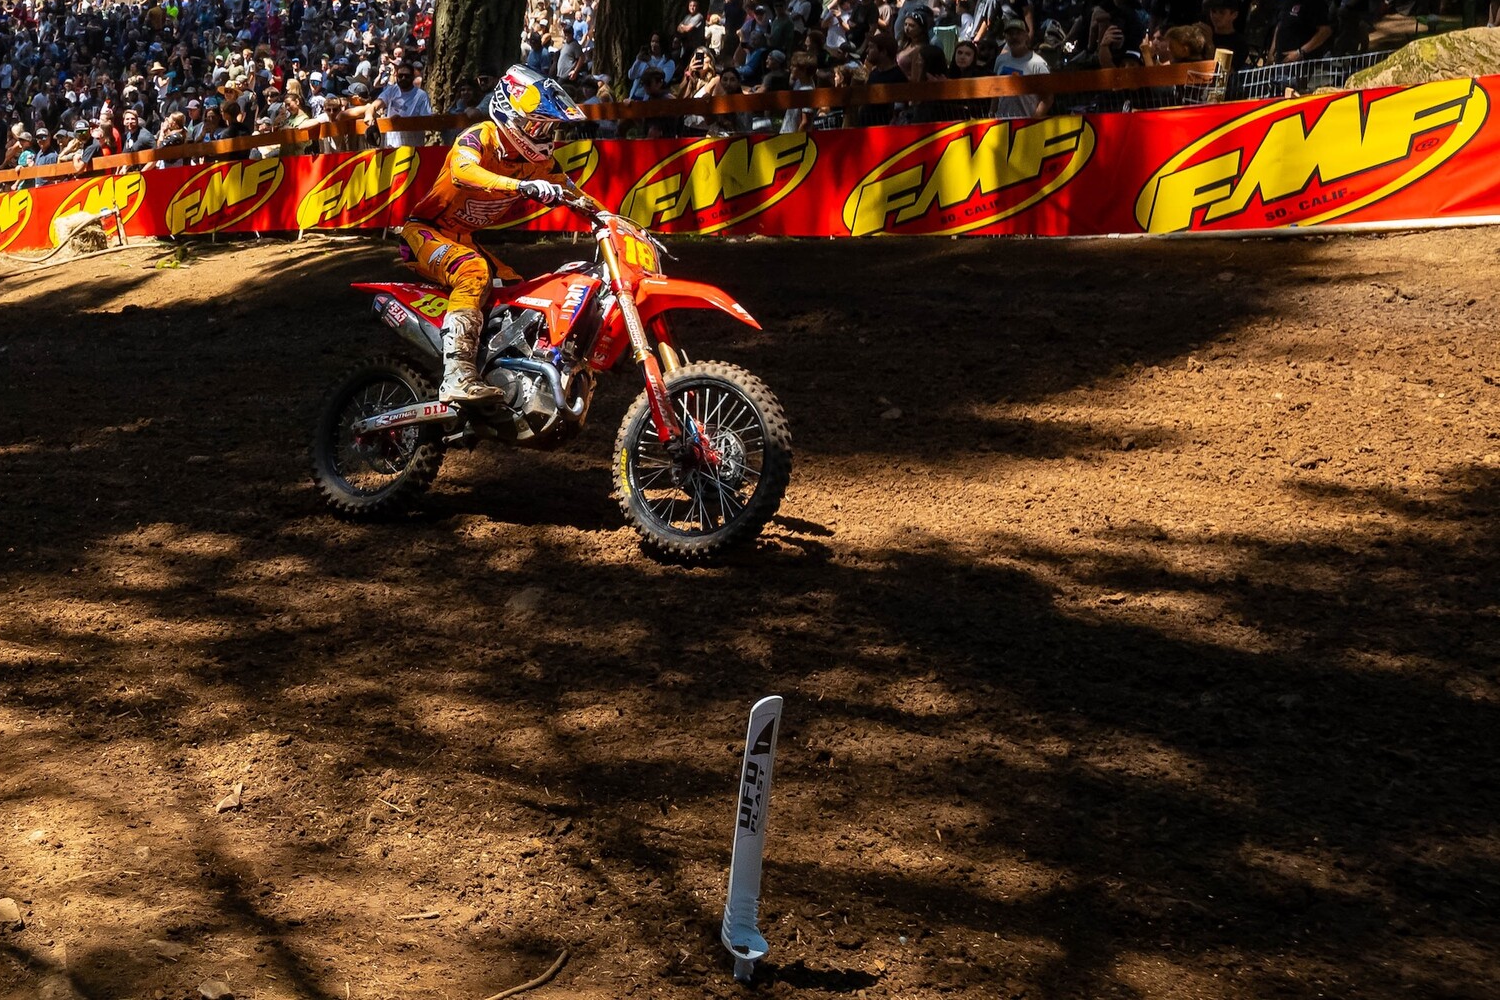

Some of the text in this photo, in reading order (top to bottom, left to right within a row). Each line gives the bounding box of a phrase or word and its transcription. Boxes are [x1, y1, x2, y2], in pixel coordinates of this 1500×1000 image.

[299, 145, 416, 230] FMF
[628, 131, 808, 229] FMF
[851, 115, 1083, 237] FMF
[1148, 77, 1476, 234] FMF
[172, 157, 280, 235] FMF
[1264, 187, 1355, 222] SO. CALIF.
[623, 235, 656, 273] 18
[410, 293, 450, 318] 18
[739, 761, 759, 829] UFO
